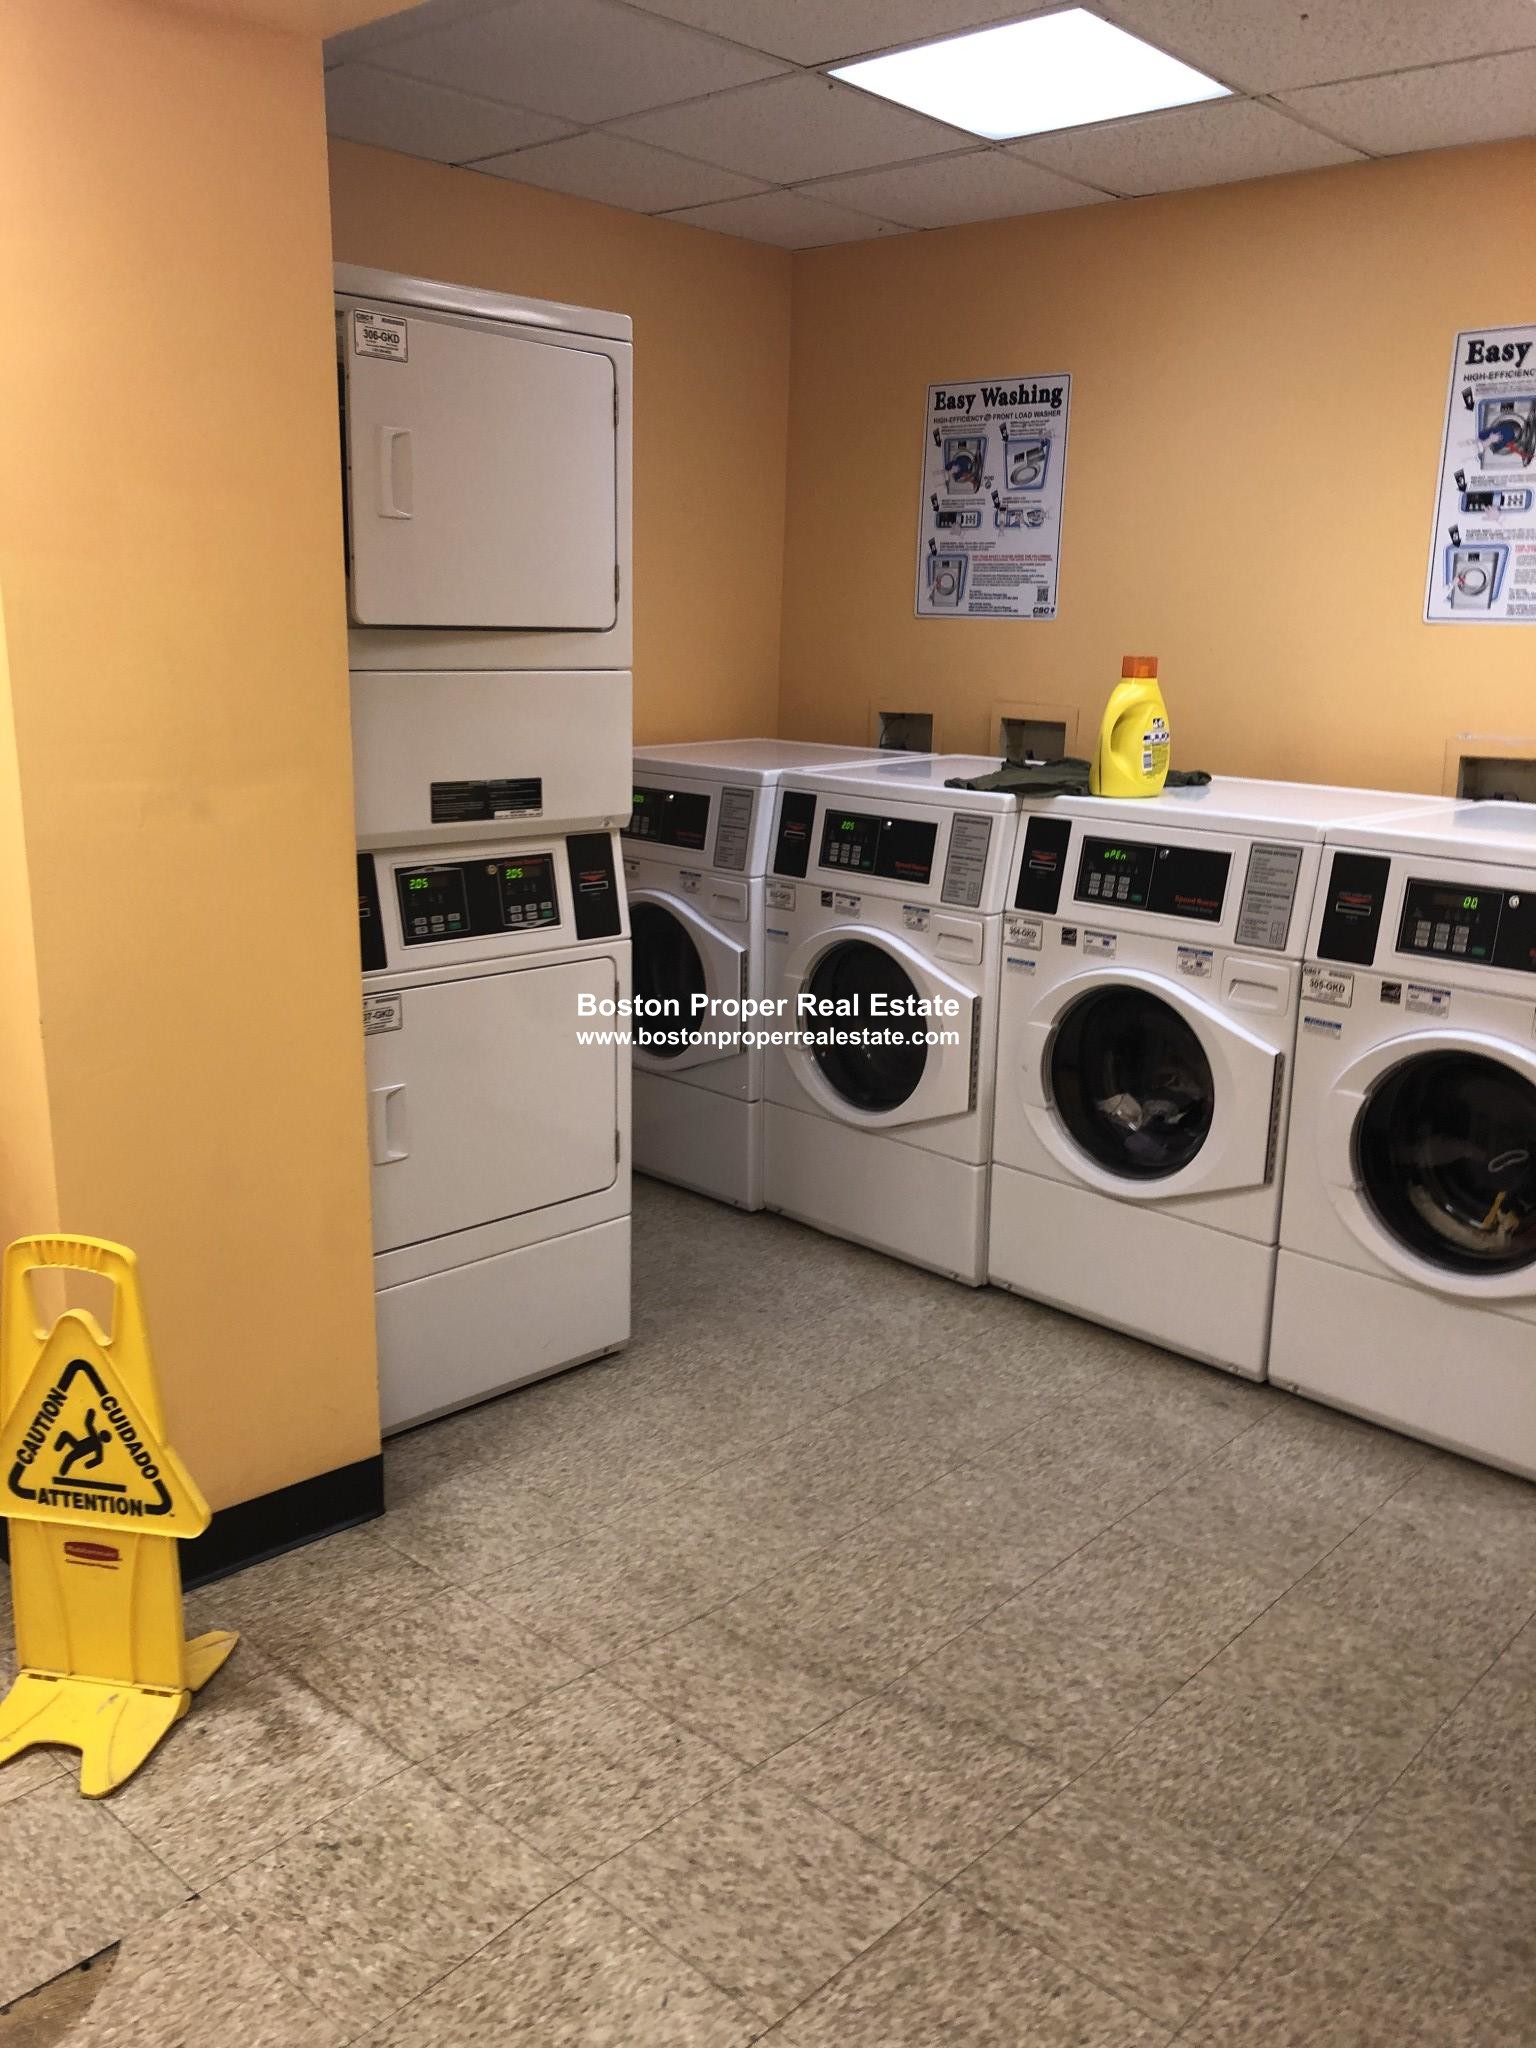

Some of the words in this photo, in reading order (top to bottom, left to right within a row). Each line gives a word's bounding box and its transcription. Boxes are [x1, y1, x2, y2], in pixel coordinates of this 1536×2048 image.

[1465, 339, 1533, 368] Easy
[934, 391, 976, 414] Easy
[980, 384, 1063, 409] Washing
[933, 415, 984, 424] HIGH-EFFICIENCY
[993, 412, 1013, 420] FRONT
[1015, 411, 1032, 419] LOAD
[1034, 410, 1061, 418] WASHER
[16, 1386, 68, 1465] CAUTION
[101, 1395, 160, 1480] CUIDADO
[38, 1488, 143, 1517] ATTENTION
